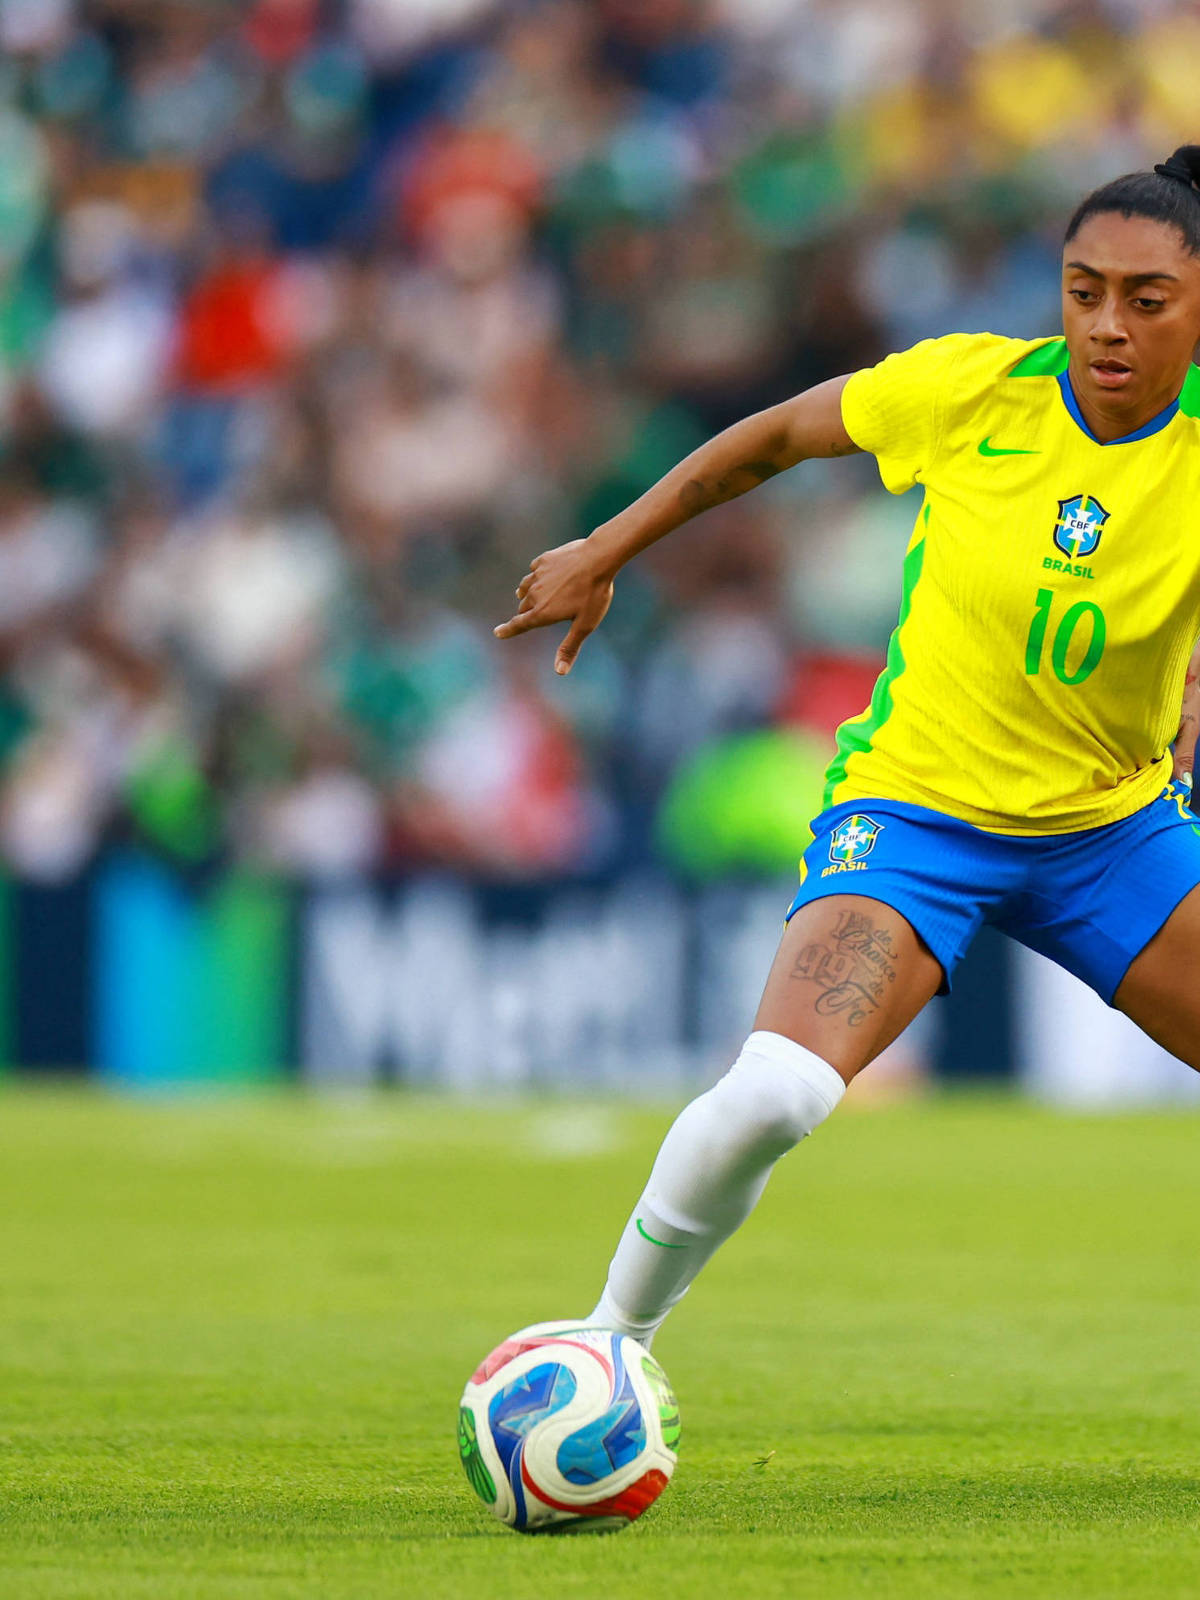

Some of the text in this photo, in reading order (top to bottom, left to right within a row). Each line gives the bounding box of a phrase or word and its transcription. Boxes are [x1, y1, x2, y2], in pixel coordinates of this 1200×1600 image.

[1070, 519, 1090, 532] CBF
[1042, 558, 1095, 579] BRASIL
[1025, 588, 1106, 685] 10
[821, 861, 868, 878] BRASIL
